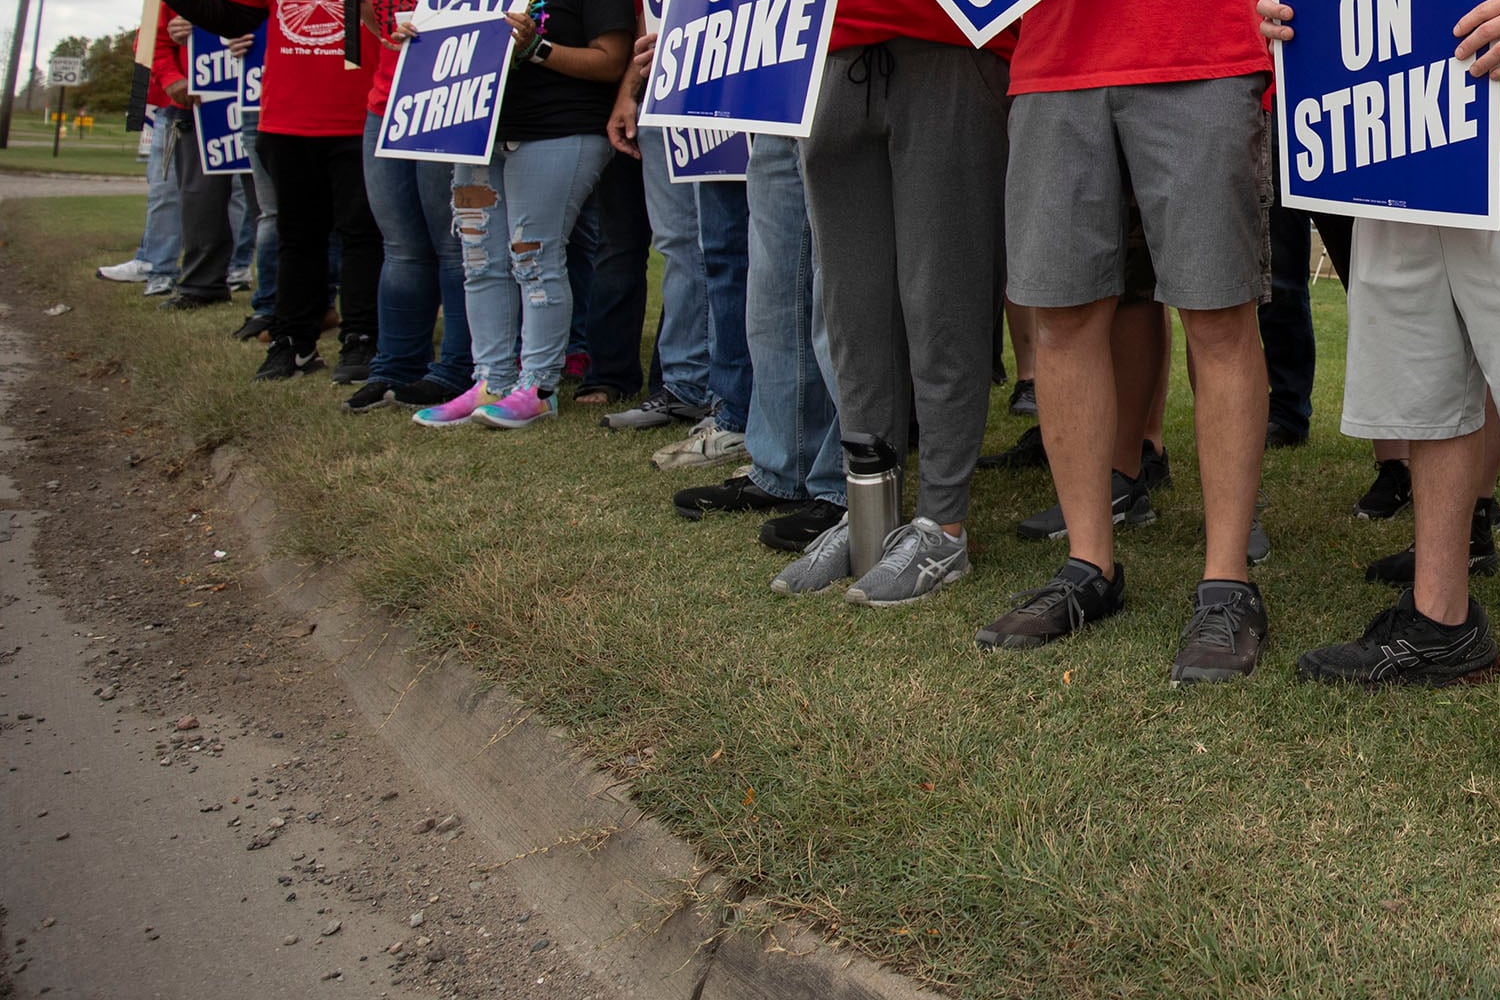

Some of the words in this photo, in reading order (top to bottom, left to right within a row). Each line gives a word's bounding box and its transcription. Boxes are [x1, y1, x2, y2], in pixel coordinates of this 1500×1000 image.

[195, 48, 239, 87] STR
[281, 47, 293, 55] Not
[295, 47, 312, 55] The
[313, 47, 345, 56] Crumb
[432, 30, 480, 82] ON
[53, 71, 77, 82] 50
[226, 101, 241, 131] O
[388, 72, 497, 142] STRIKE
[1294, 53, 1478, 182] STRIKE
